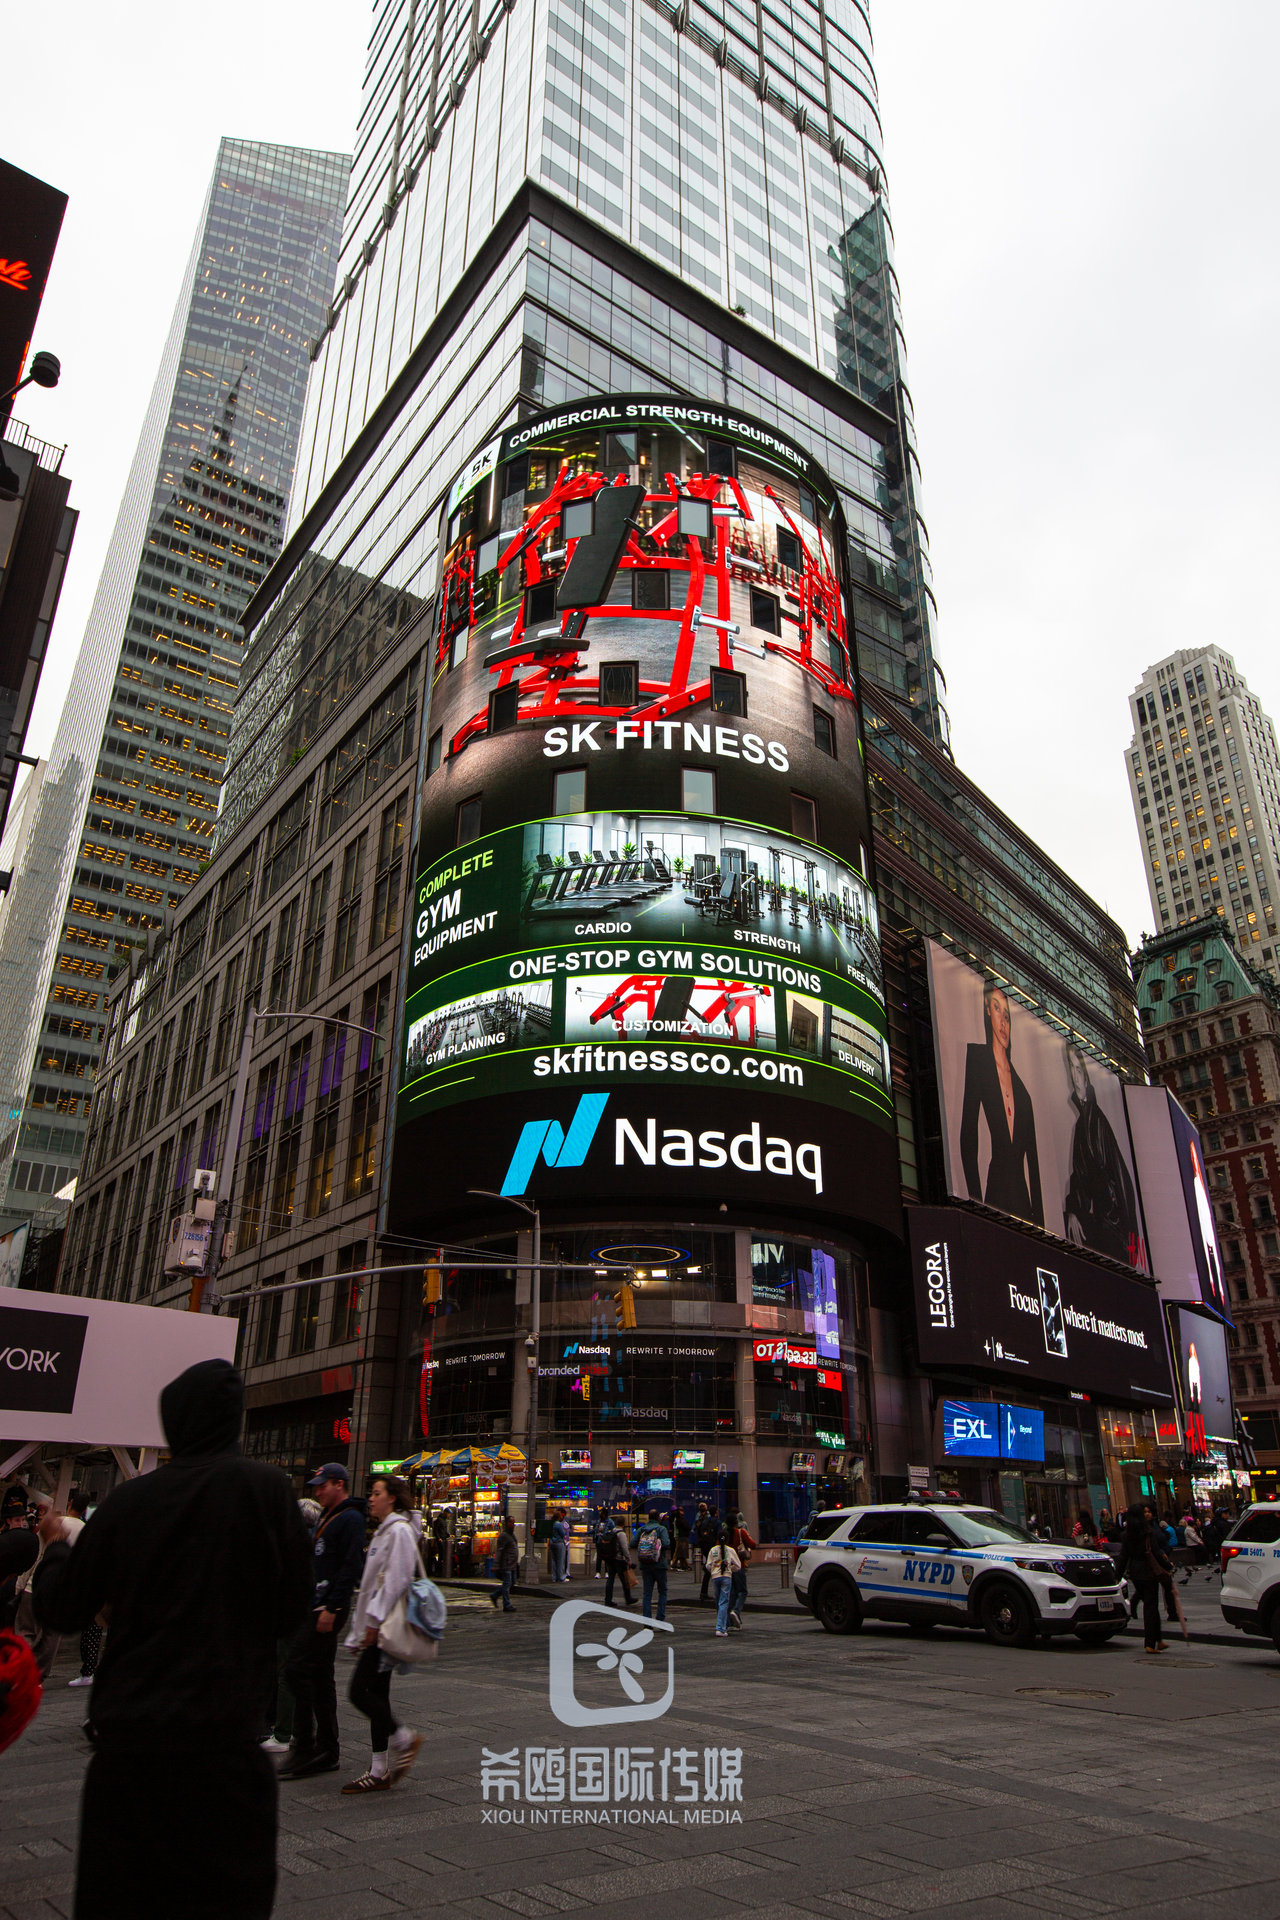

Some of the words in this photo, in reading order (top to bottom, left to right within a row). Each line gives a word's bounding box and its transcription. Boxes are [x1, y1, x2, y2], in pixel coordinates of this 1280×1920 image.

[509, 405, 622, 449] COMMERCIAL
[625, 404, 723, 427] STRENGTH
[727, 417, 809, 472] EQUIPMENT
[471, 450, 493, 477] SK
[542, 720, 602, 758] SK
[615, 719, 790, 773] FITNESS
[419, 849, 494, 904] COMPLETE
[416, 888, 462, 939] GYM
[414, 910, 498, 967] EQUIPMENT
[574, 921, 632, 936] CARDIO
[733, 929, 802, 954] STRENGTH
[508, 948, 631, 981] ONE-STOP
[637, 949, 693, 970] GYM
[700, 952, 822, 994] SOLUTIONS
[847, 964, 866, 985] FREE
[611, 1019, 734, 1037] CUSTOMIZATION
[426, 1047, 446, 1065] GYM
[447, 1032, 506, 1057] PLANNING
[532, 1046, 804, 1086] skfitnessco.com
[838, 1049, 876, 1078] DELIVERY
[614, 1117, 824, 1195] Nasdaq
[925, 1242, 948, 1328] LEGORA
[1008, 1283, 1040, 1316] Focus
[1063, 1304, 1091, 1332] where
[1089, 1311, 1098, 1334] it
[1097, 1319, 1128, 1343] matters
[1127, 1328, 1148, 1349] most.
[469, 1351, 506, 1362] TOMORROW
[578, 1345, 611, 1356] Nasdaq
[626, 1346, 664, 1355] REWRITE
[667, 1347, 718, 1356] TOMORROW
[623, 1405, 668, 1420] Nasdaq
[953, 1418, 993, 1439] EXL
[1019, 1424, 1033, 1435] Beyond
[983, 1553, 1005, 1561] POLICE
[903, 1559, 955, 1586] NYPD
